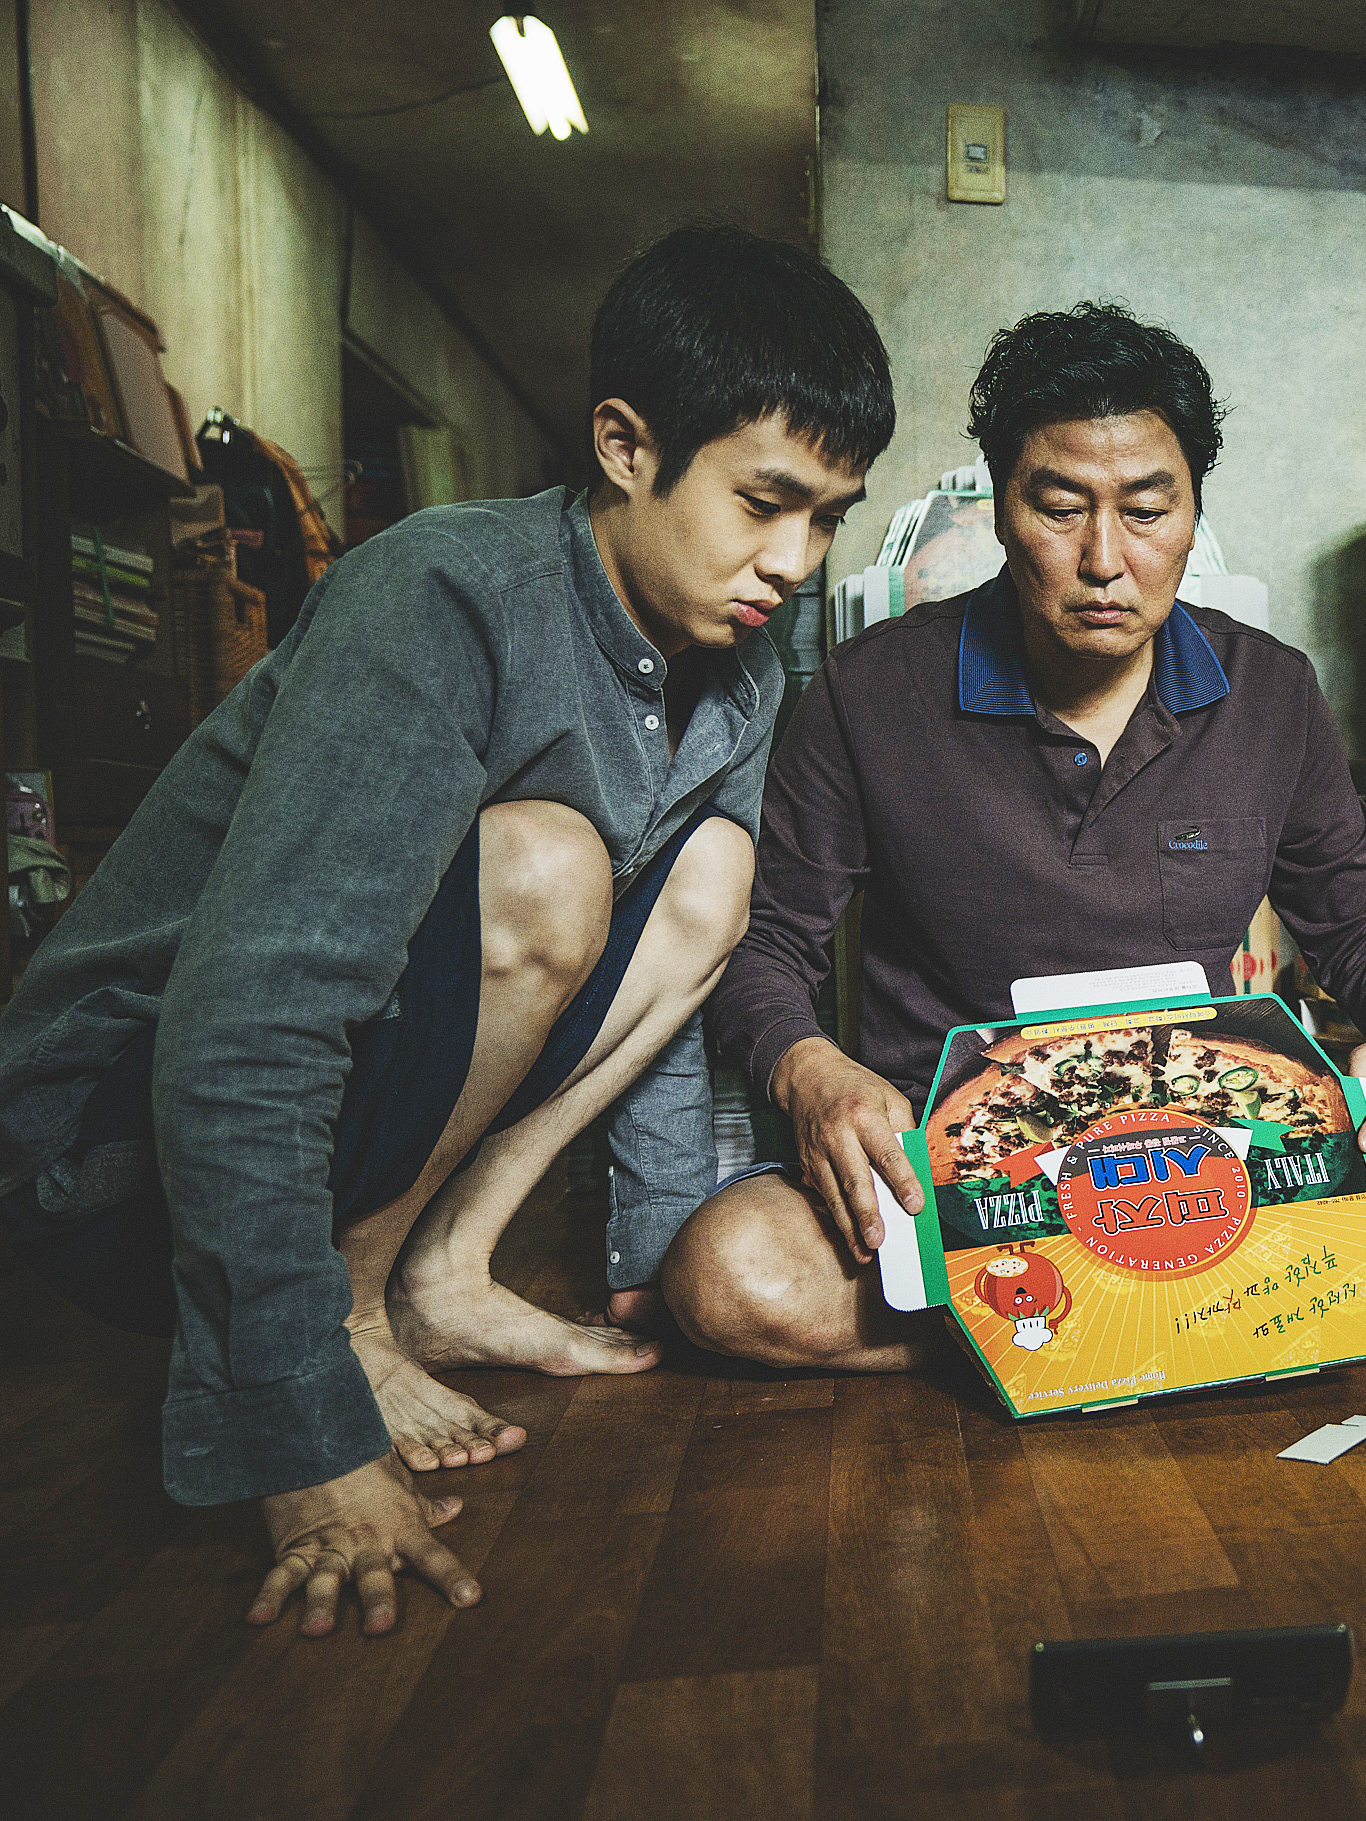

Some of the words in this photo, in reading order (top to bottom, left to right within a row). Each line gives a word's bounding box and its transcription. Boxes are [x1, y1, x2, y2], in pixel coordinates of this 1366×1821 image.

[1169, 840, 1208, 849] Crocodile
[1120, 1113, 1170, 1124] PIZZA
[1076, 1122, 1113, 1149] PURE
[1193, 1124, 1235, 1160] SINCE
[1067, 1156, 1077, 1164] &
[1087, 1143, 1212, 1190] 시대
[1264, 1152, 1331, 1190] ITALY
[1060, 1172, 1077, 1220] FRESH
[1232, 1166, 1246, 1199] 2010
[974, 1190, 1045, 1230] PIZZA
[1092, 1188, 1230, 1236] 피자
[1204, 1217, 1242, 1254] PIZZA
[1086, 1236, 1198, 1270] GENERATION
[1285, 1245, 1337, 1287] 푸짐한
[1243, 1277, 1279, 1295] 양과
[1309, 1283, 1356, 1318] 신선한
[1253, 1307, 1304, 1338] 재료와
[1068, 1381, 1109, 1395] Delivery
[1111, 1377, 1137, 1386] Pizza
[1140, 1371, 1167, 1381] Home
[1028, 1387, 1065, 1400] Service
